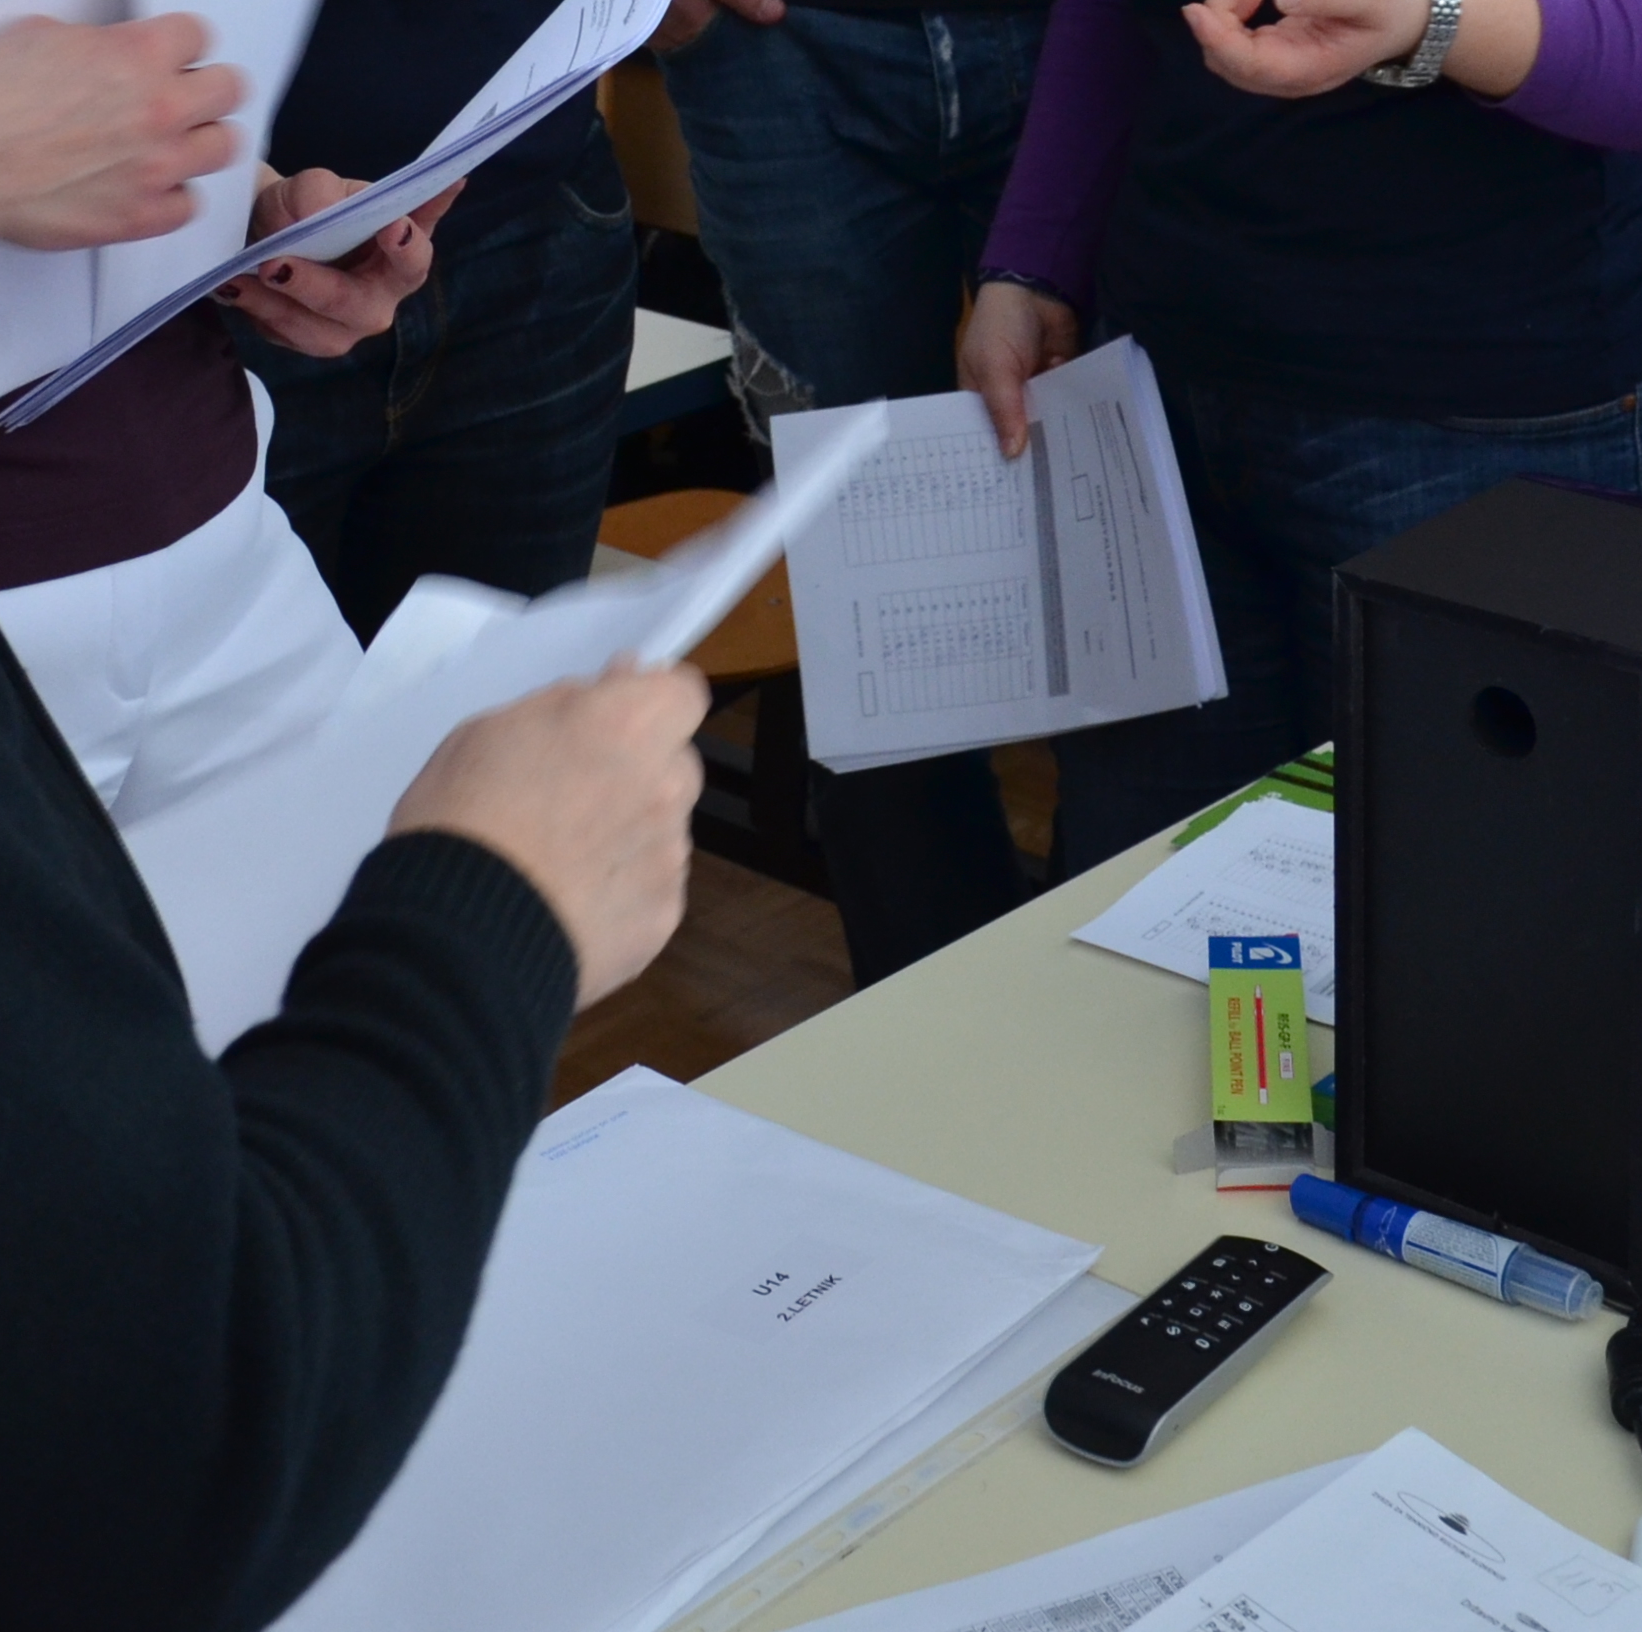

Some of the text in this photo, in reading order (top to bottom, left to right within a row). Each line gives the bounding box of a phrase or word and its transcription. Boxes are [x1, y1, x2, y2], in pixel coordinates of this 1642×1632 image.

[1229, 1031, 1242, 1051] BALL
[1230, 1052, 1244, 1077] POINT
[1231, 1078, 1245, 1096] PEN
[752, 1272, 790, 1296] U14
